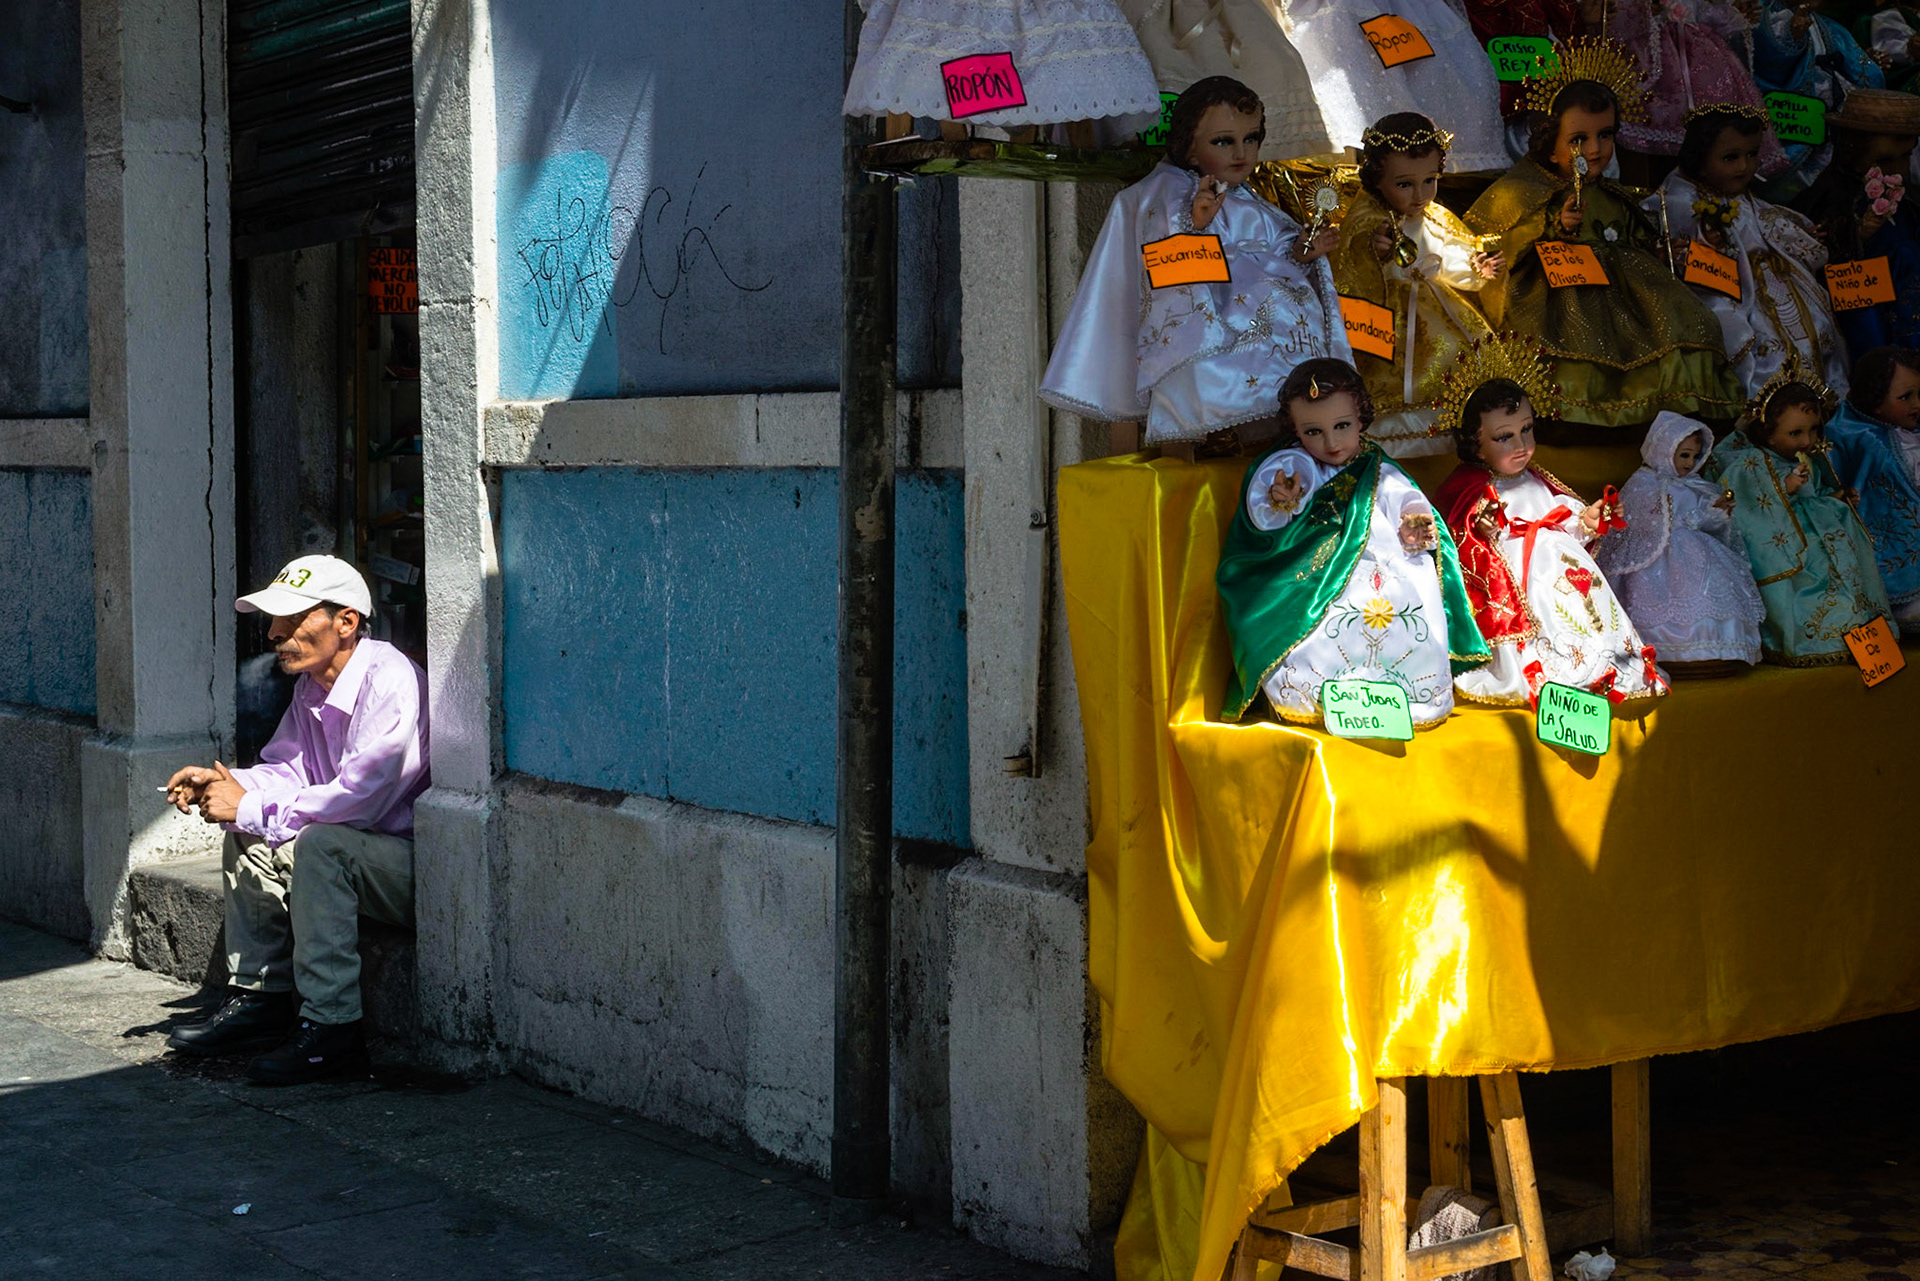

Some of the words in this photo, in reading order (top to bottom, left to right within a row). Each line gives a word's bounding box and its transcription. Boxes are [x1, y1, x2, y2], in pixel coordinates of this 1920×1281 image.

[946, 66, 1014, 104] ROPÓN
[1776, 111, 1798, 121] DEL
[368, 267, 417, 282] MERCA
[1825, 259, 1863, 279] Santo
[1863, 274, 1878, 287] de
[384, 283, 405, 296] NO
[1549, 687, 1580, 713] NIÑO
[1583, 703, 1599, 717] DE
[1541, 708, 1555, 726] LA
